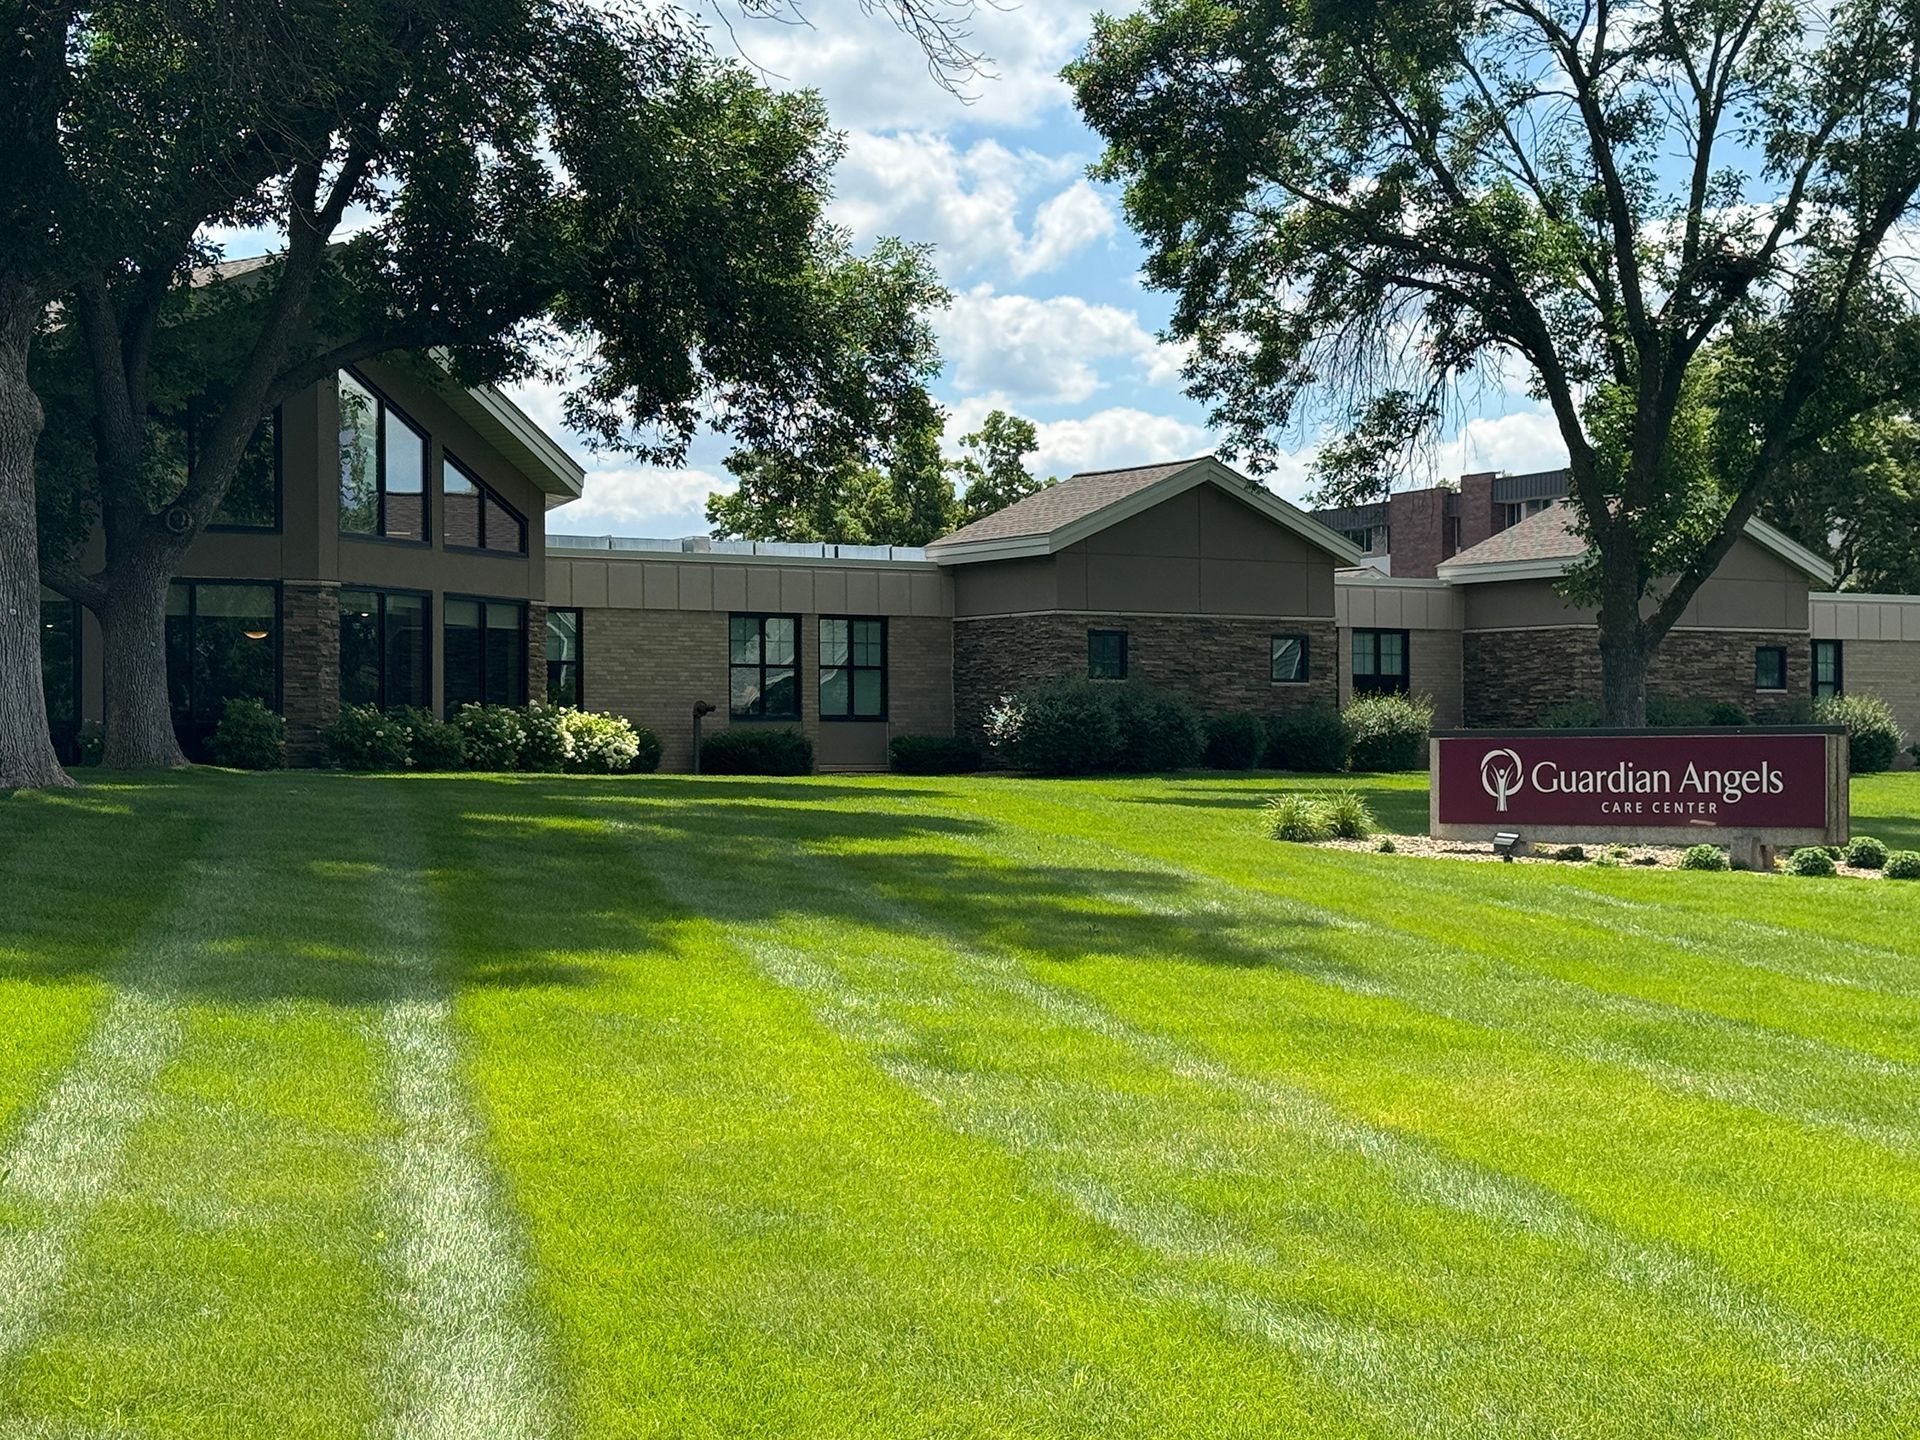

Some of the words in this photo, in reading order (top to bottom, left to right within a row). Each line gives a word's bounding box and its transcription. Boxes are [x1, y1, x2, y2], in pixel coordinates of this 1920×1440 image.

[1531, 760, 1670, 793] Guardian
[1678, 760, 1783, 804] Angels
[1600, 801, 1643, 814] CARE
[1651, 801, 1718, 814] CENTER
